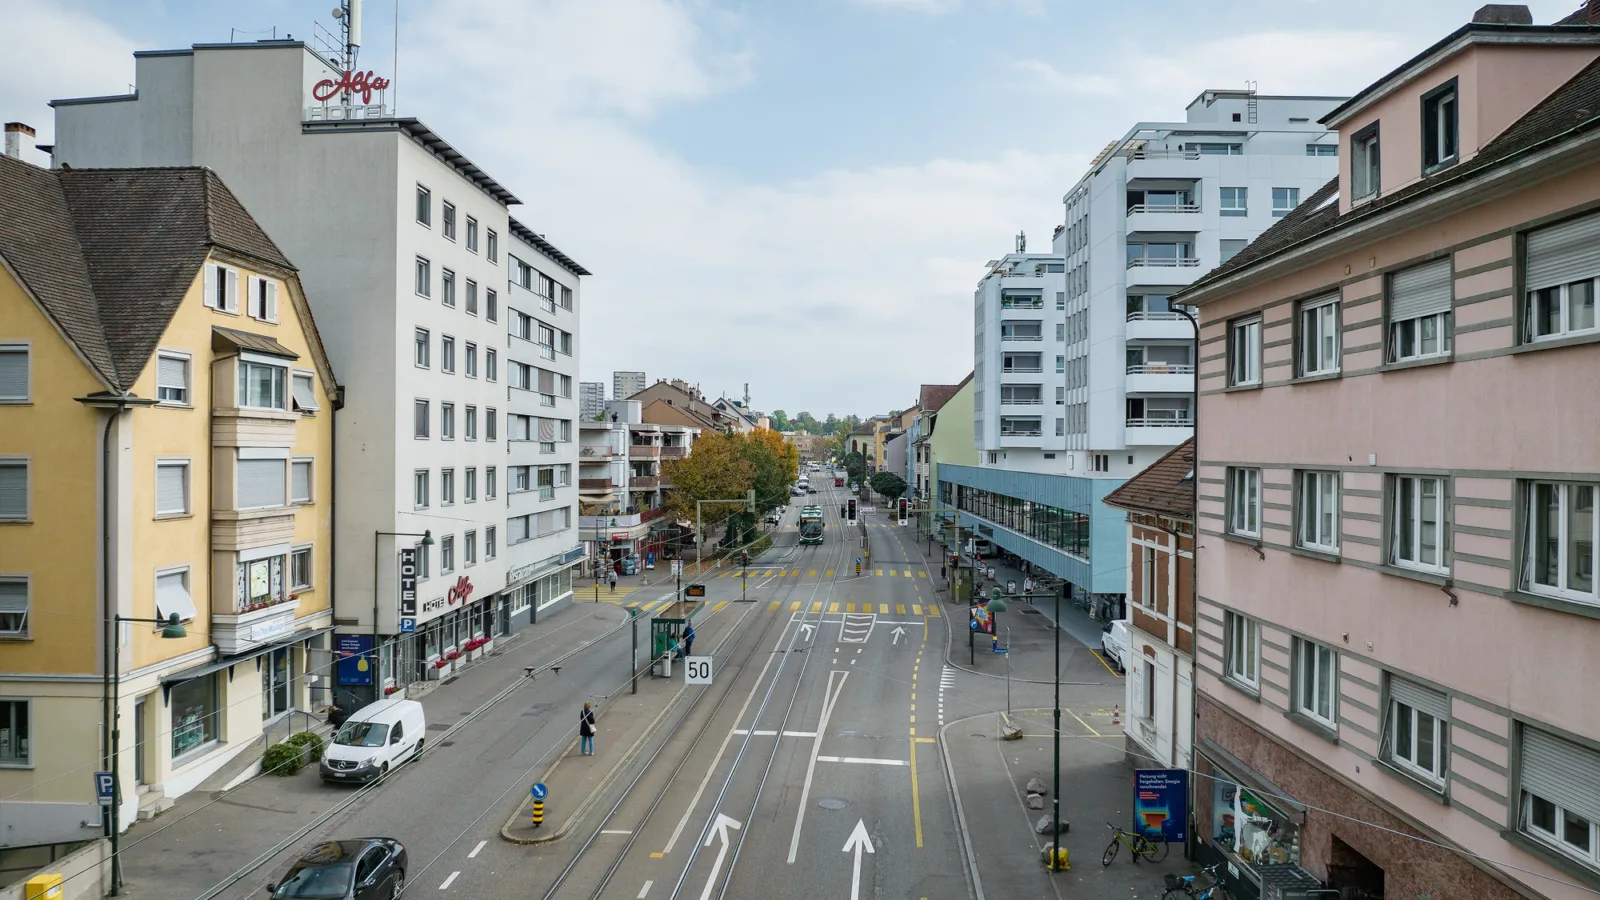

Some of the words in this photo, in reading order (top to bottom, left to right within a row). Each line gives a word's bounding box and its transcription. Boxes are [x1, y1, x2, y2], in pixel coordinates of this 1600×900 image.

[312, 70, 390, 104] Alfa
[307, 104, 395, 120] HOTEL
[402, 552, 415, 613] HOTEL
[403, 619, 412, 628] P
[688, 661, 709, 678] 50
[100, 775, 113, 793] P
